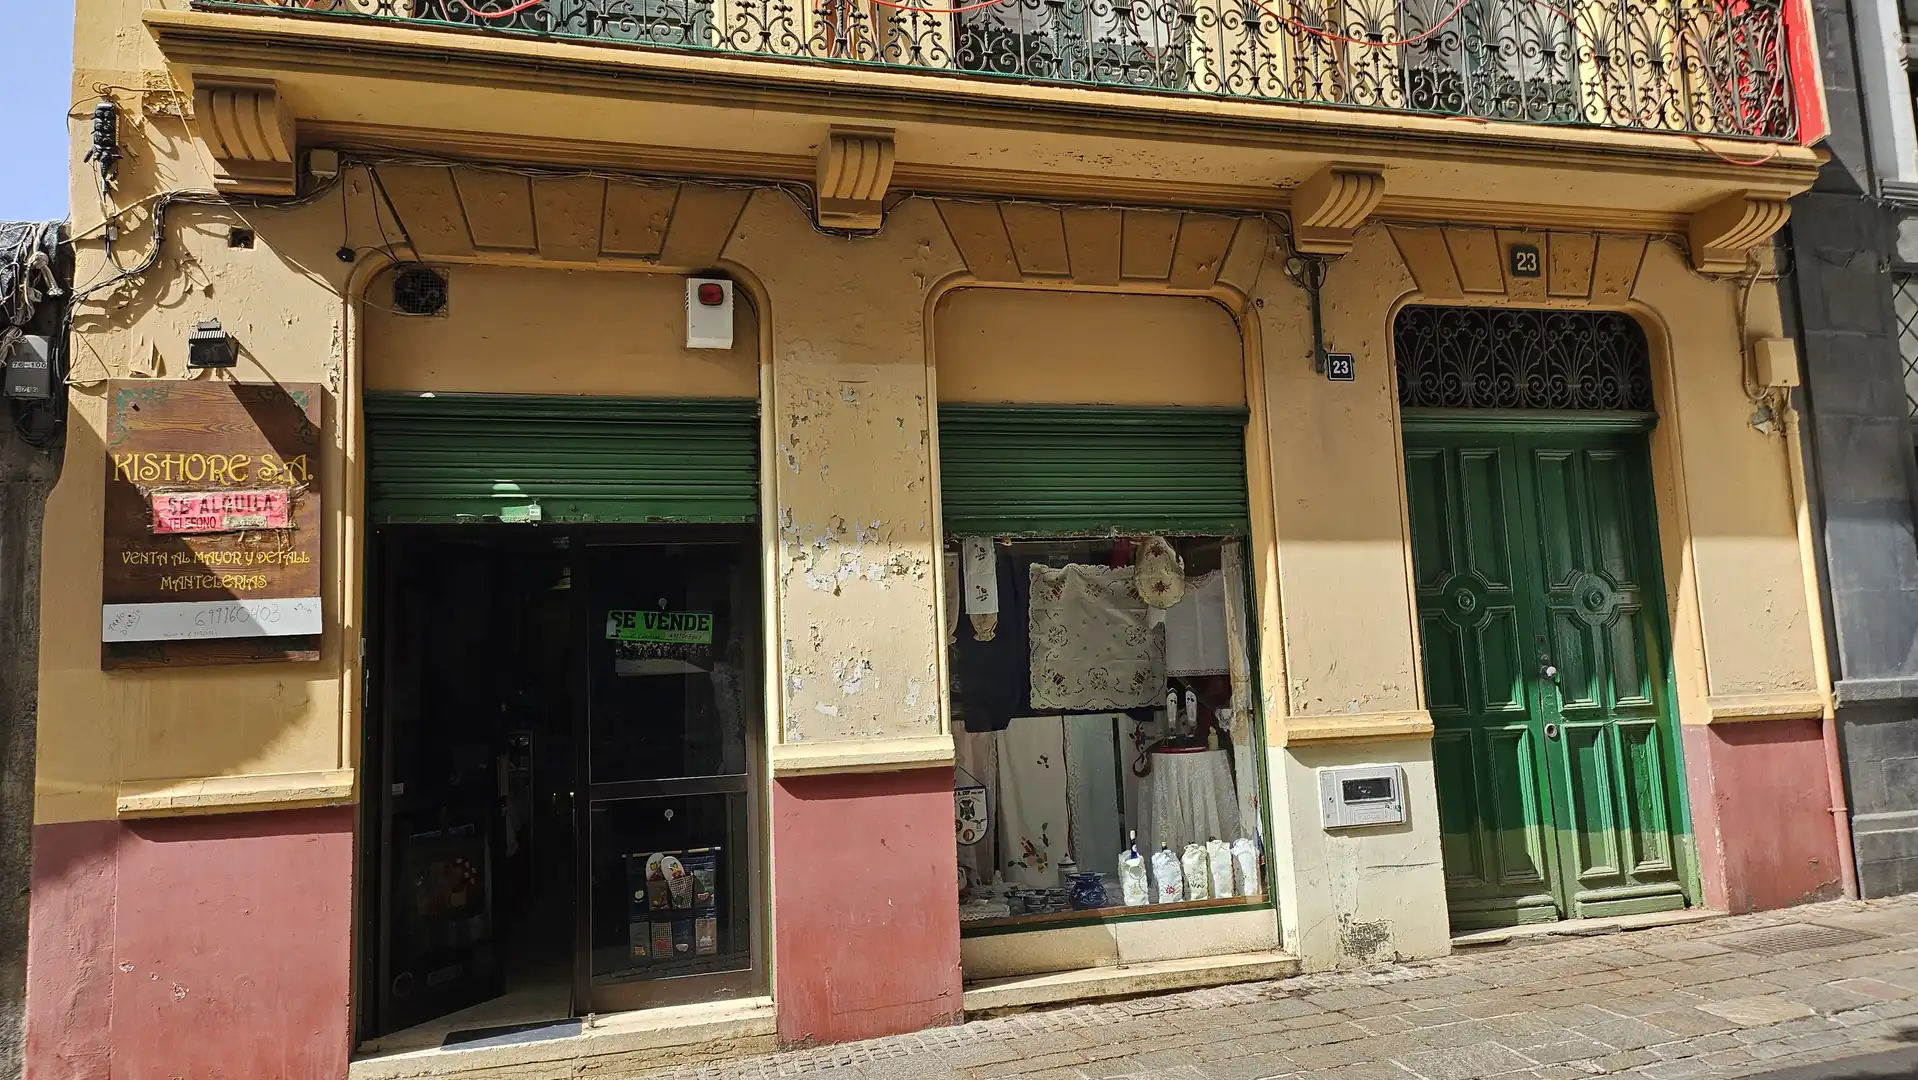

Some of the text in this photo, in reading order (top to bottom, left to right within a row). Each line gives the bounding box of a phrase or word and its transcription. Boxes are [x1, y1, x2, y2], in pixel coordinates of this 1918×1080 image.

[1516, 252, 1537, 271] 23
[1333, 360, 1349, 374] 23
[113, 453, 314, 486] KISHORE S.A.
[168, 494, 274, 515] SE ALQUILA
[122, 550, 310, 566] VENTA AL MAYOR Y DETALL
[160, 574, 267, 591] MANTELERIAS
[610, 611, 710, 631] SE VENDE
